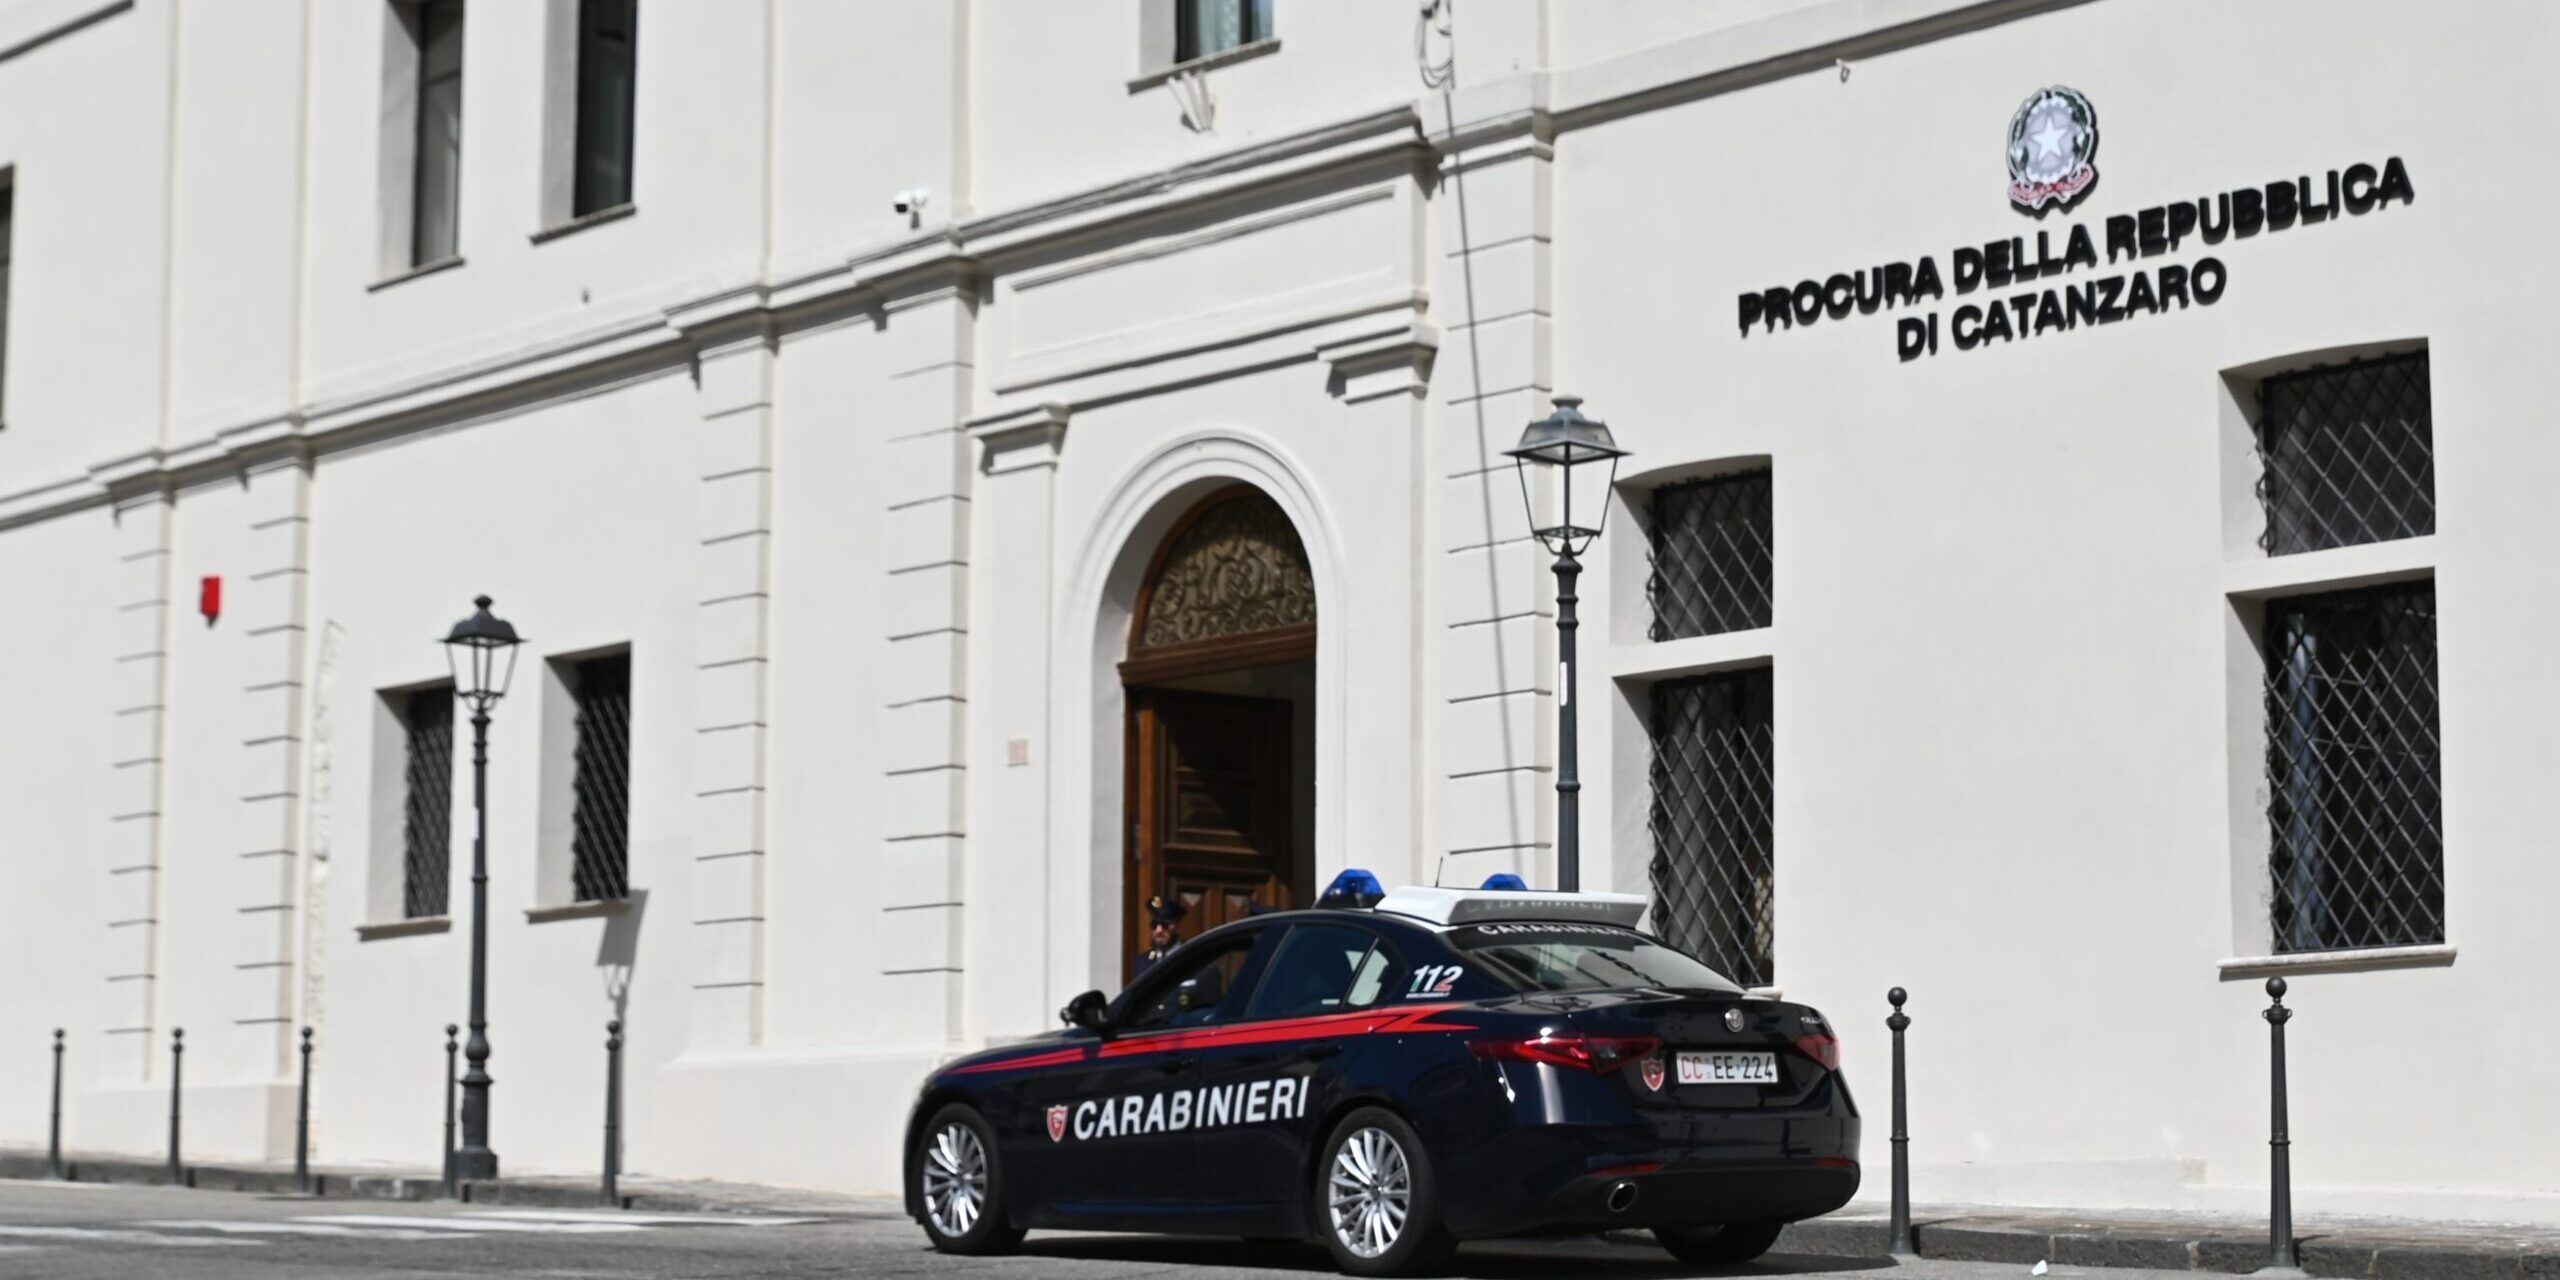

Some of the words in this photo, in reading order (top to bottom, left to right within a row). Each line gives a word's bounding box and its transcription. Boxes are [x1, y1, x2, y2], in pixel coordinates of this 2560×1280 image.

[1738, 256, 1943, 337] PROCURA
[1953, 224, 2097, 294] DELLA
[2106, 157, 2414, 263] REPUBBLICA
[1898, 313, 1938, 361] DI
[1952, 257, 2227, 349] CATANZARO
[1409, 964, 1464, 992] 112
[1681, 1055, 1704, 1079] CC
[1073, 1075, 1310, 1140] CARABINIERI
